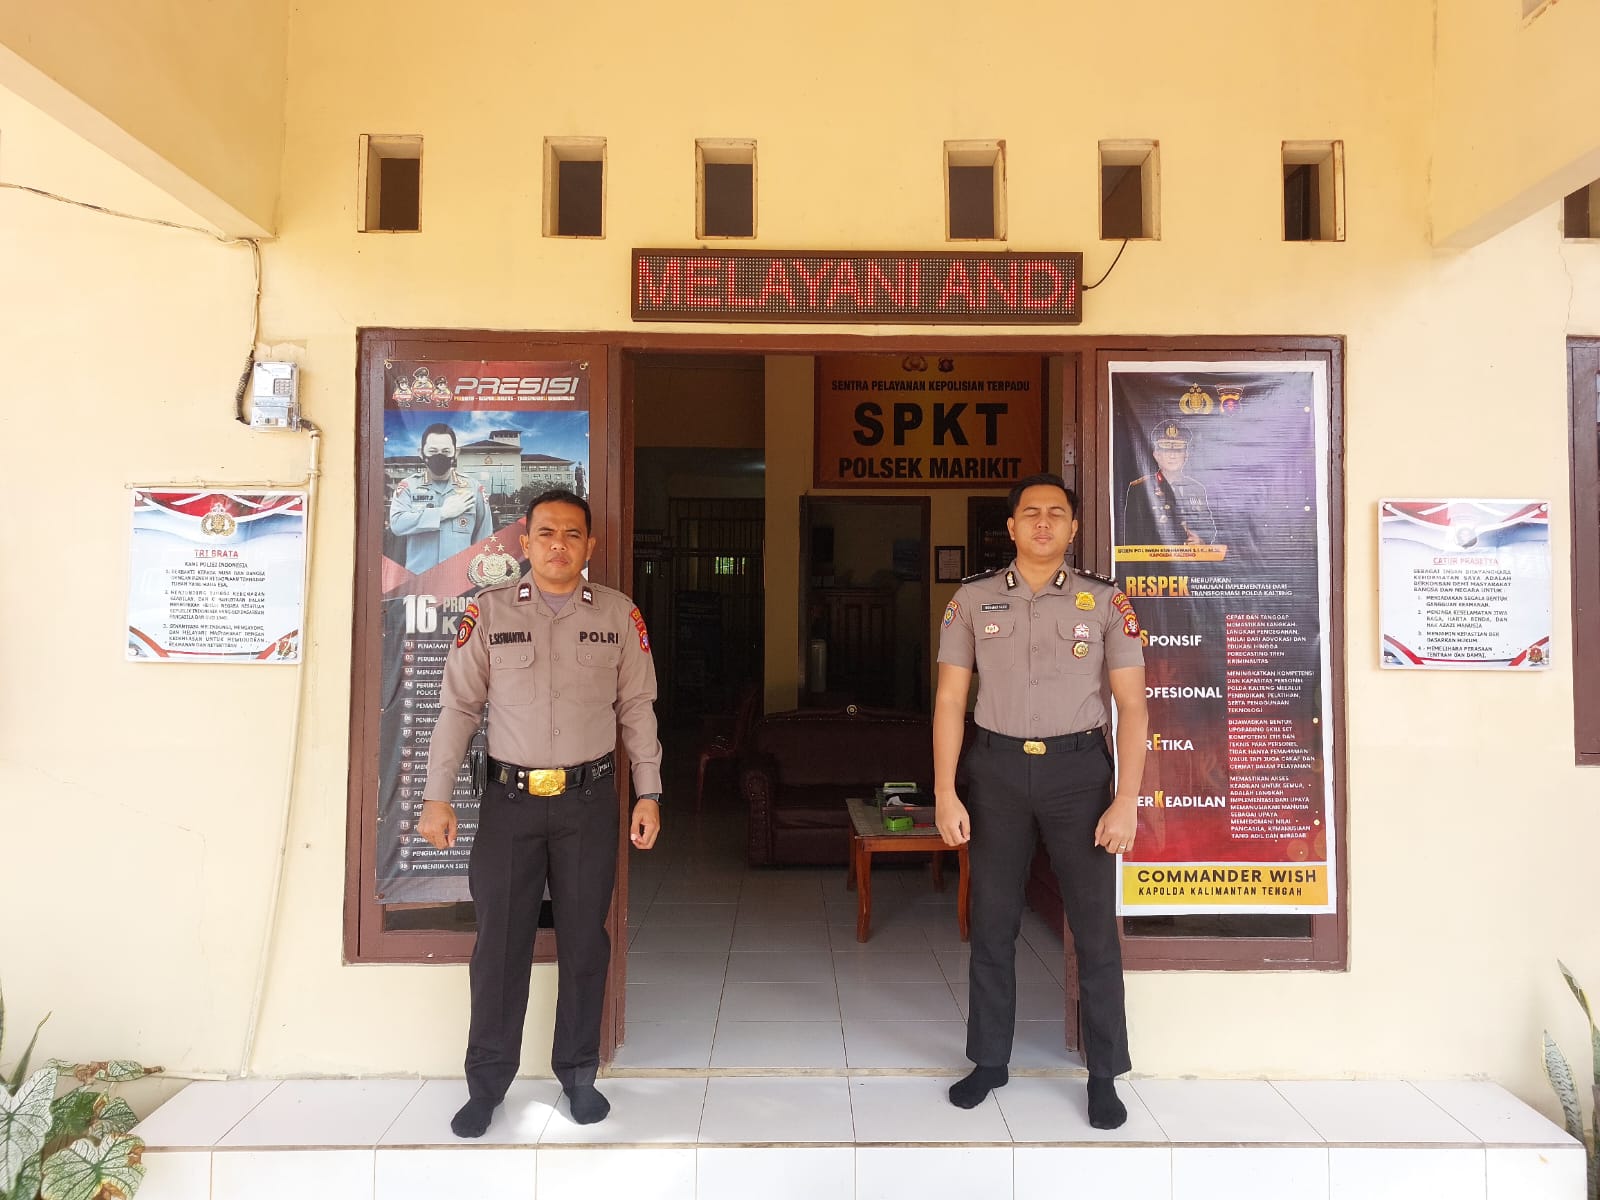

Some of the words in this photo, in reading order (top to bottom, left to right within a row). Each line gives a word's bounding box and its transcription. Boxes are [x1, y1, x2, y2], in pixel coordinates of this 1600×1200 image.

[638, 256, 920, 307] MELAYANI
[454, 377, 580, 395] PRESISI
[831, 380, 868, 391] SENTRA
[872, 380, 926, 391] PELAYANAN
[929, 380, 984, 391] KEPOLISIAN
[987, 381, 1030, 392] TERPADU
[853, 402, 1008, 446] SPKT
[839, 457, 922, 478] POLSEK
[929, 458, 1021, 479] MARIKIT
[194, 549, 209, 557] TRI
[212, 550, 238, 558] BRATA
[1126, 576, 1190, 596] RESPEK
[403, 595, 437, 634] 16
[579, 631, 619, 644] POLRI
[1137, 869, 1262, 883] COMMANDER
[1269, 869, 1316, 883] WISH
[1138, 886, 1185, 896] KAPOLDA
[1190, 886, 1257, 896] KALIMANTAN
[1262, 887, 1302, 896] TENGAH
